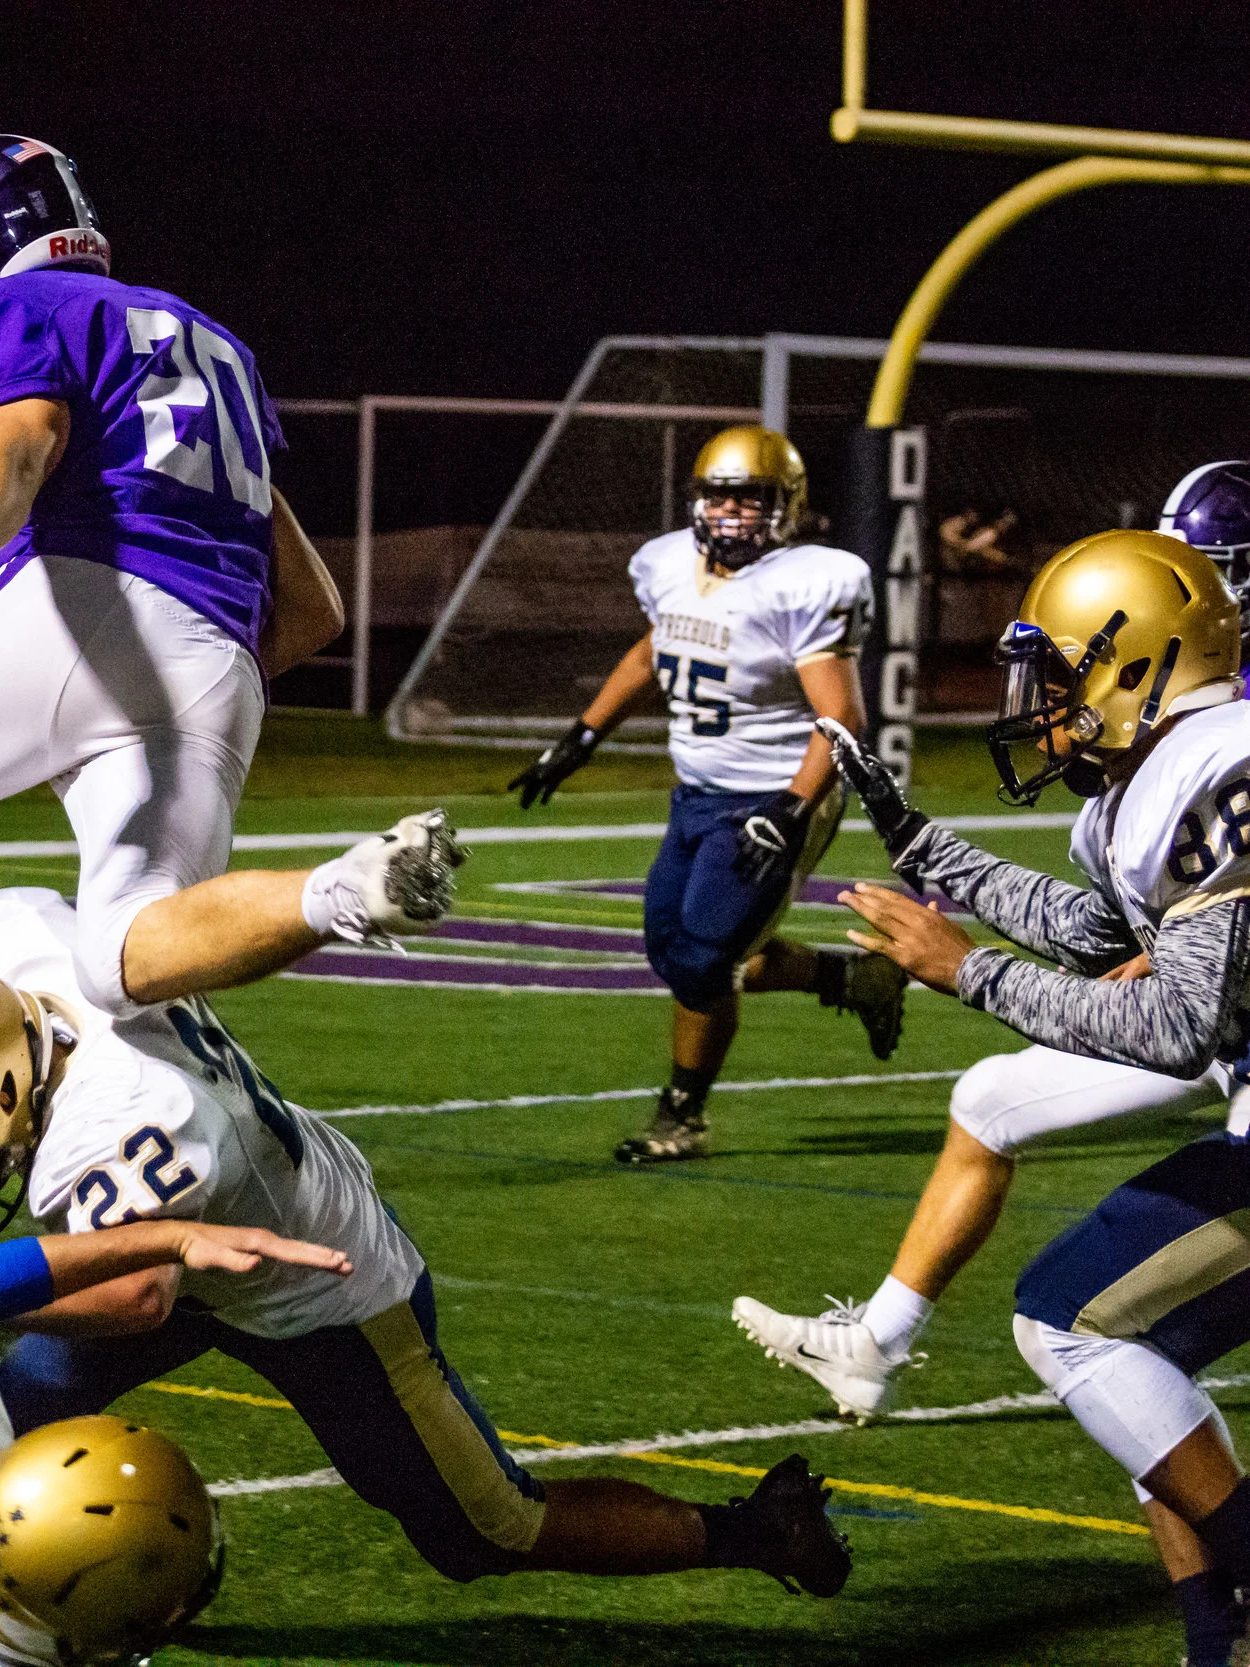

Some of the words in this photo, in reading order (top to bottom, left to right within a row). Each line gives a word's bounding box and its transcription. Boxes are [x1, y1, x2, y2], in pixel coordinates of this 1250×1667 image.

[127, 308, 273, 518] 20
[656, 652, 732, 737] 75
[71, 1121, 204, 1230] 22
